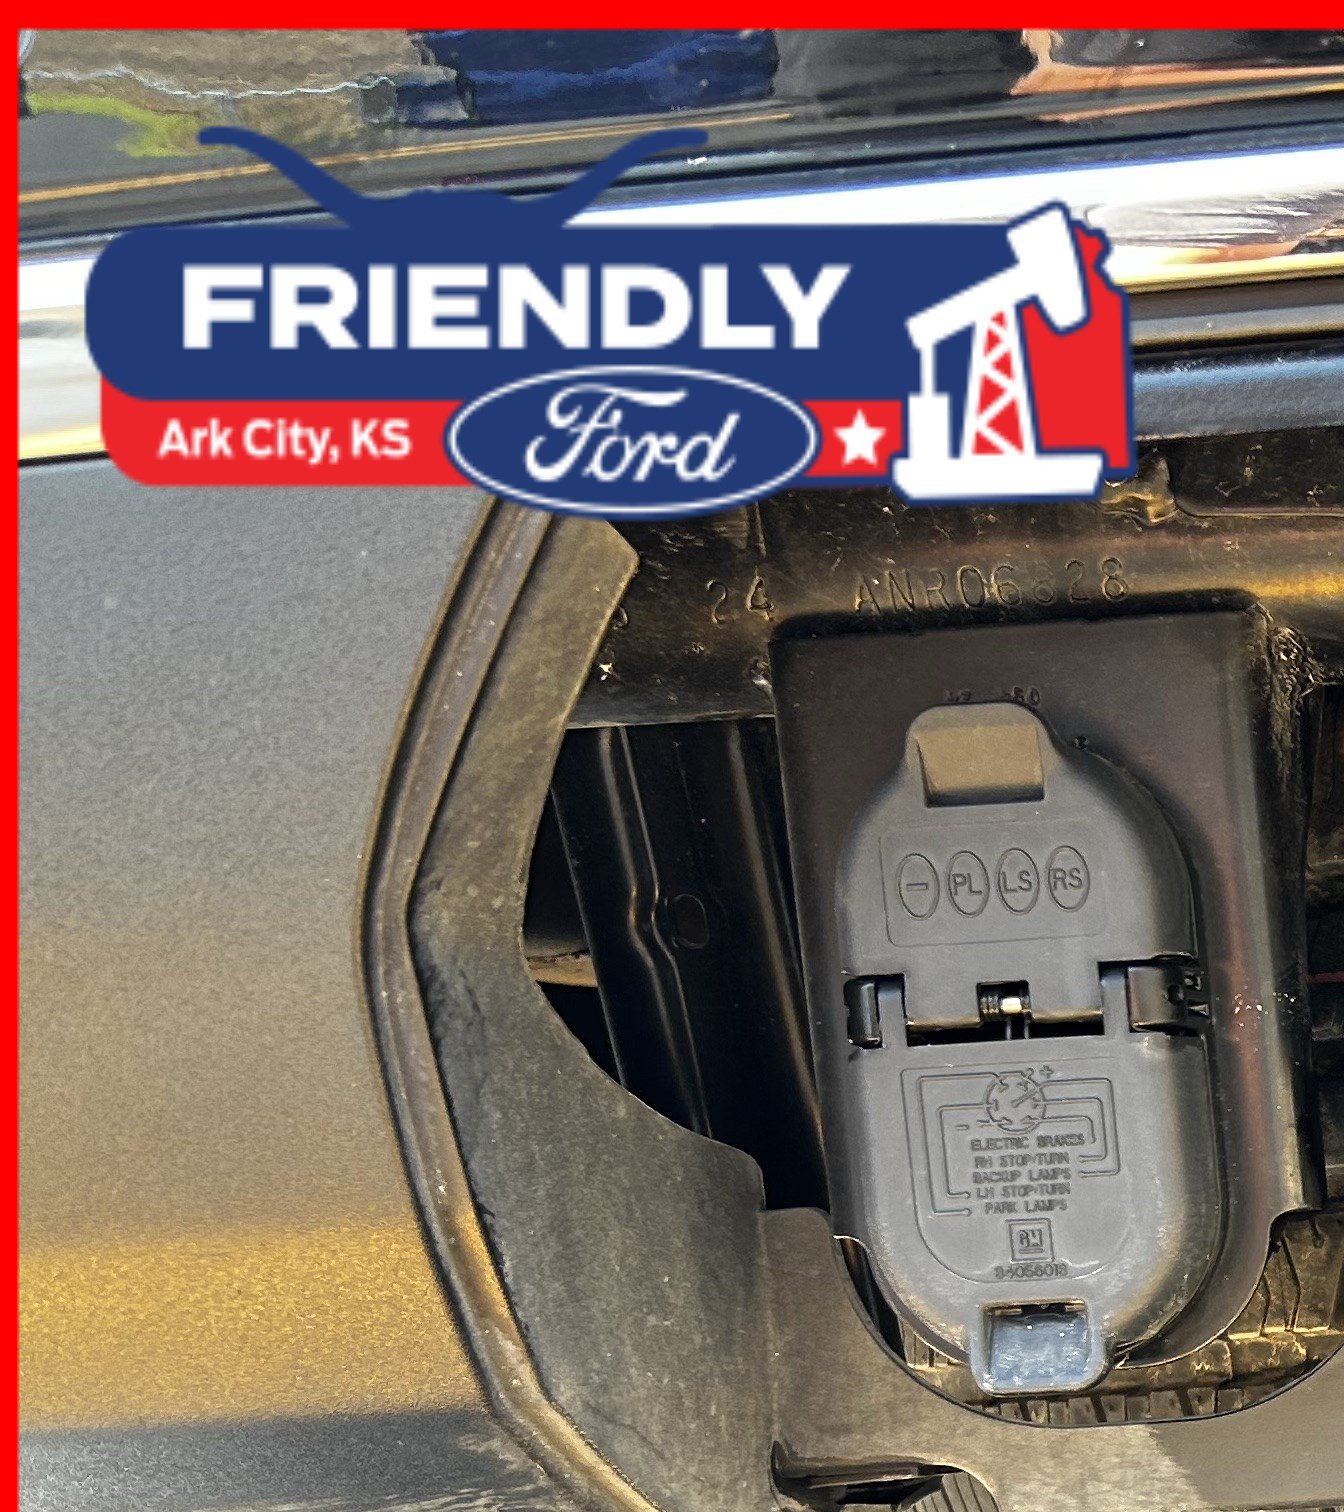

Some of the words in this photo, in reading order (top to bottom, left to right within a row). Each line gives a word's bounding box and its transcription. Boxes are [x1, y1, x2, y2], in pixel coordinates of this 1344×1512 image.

[951, 872, 982, 897] PL
[1001, 869, 1033, 895] LS
[1052, 866, 1083, 891] RS
[970, 1136, 1030, 1151] ELECTRIC
[1028, 1167, 1072, 1182] LAMPS
[985, 1201, 1018, 1215] PARK
[1024, 1198, 1068, 1213] LAMPS
